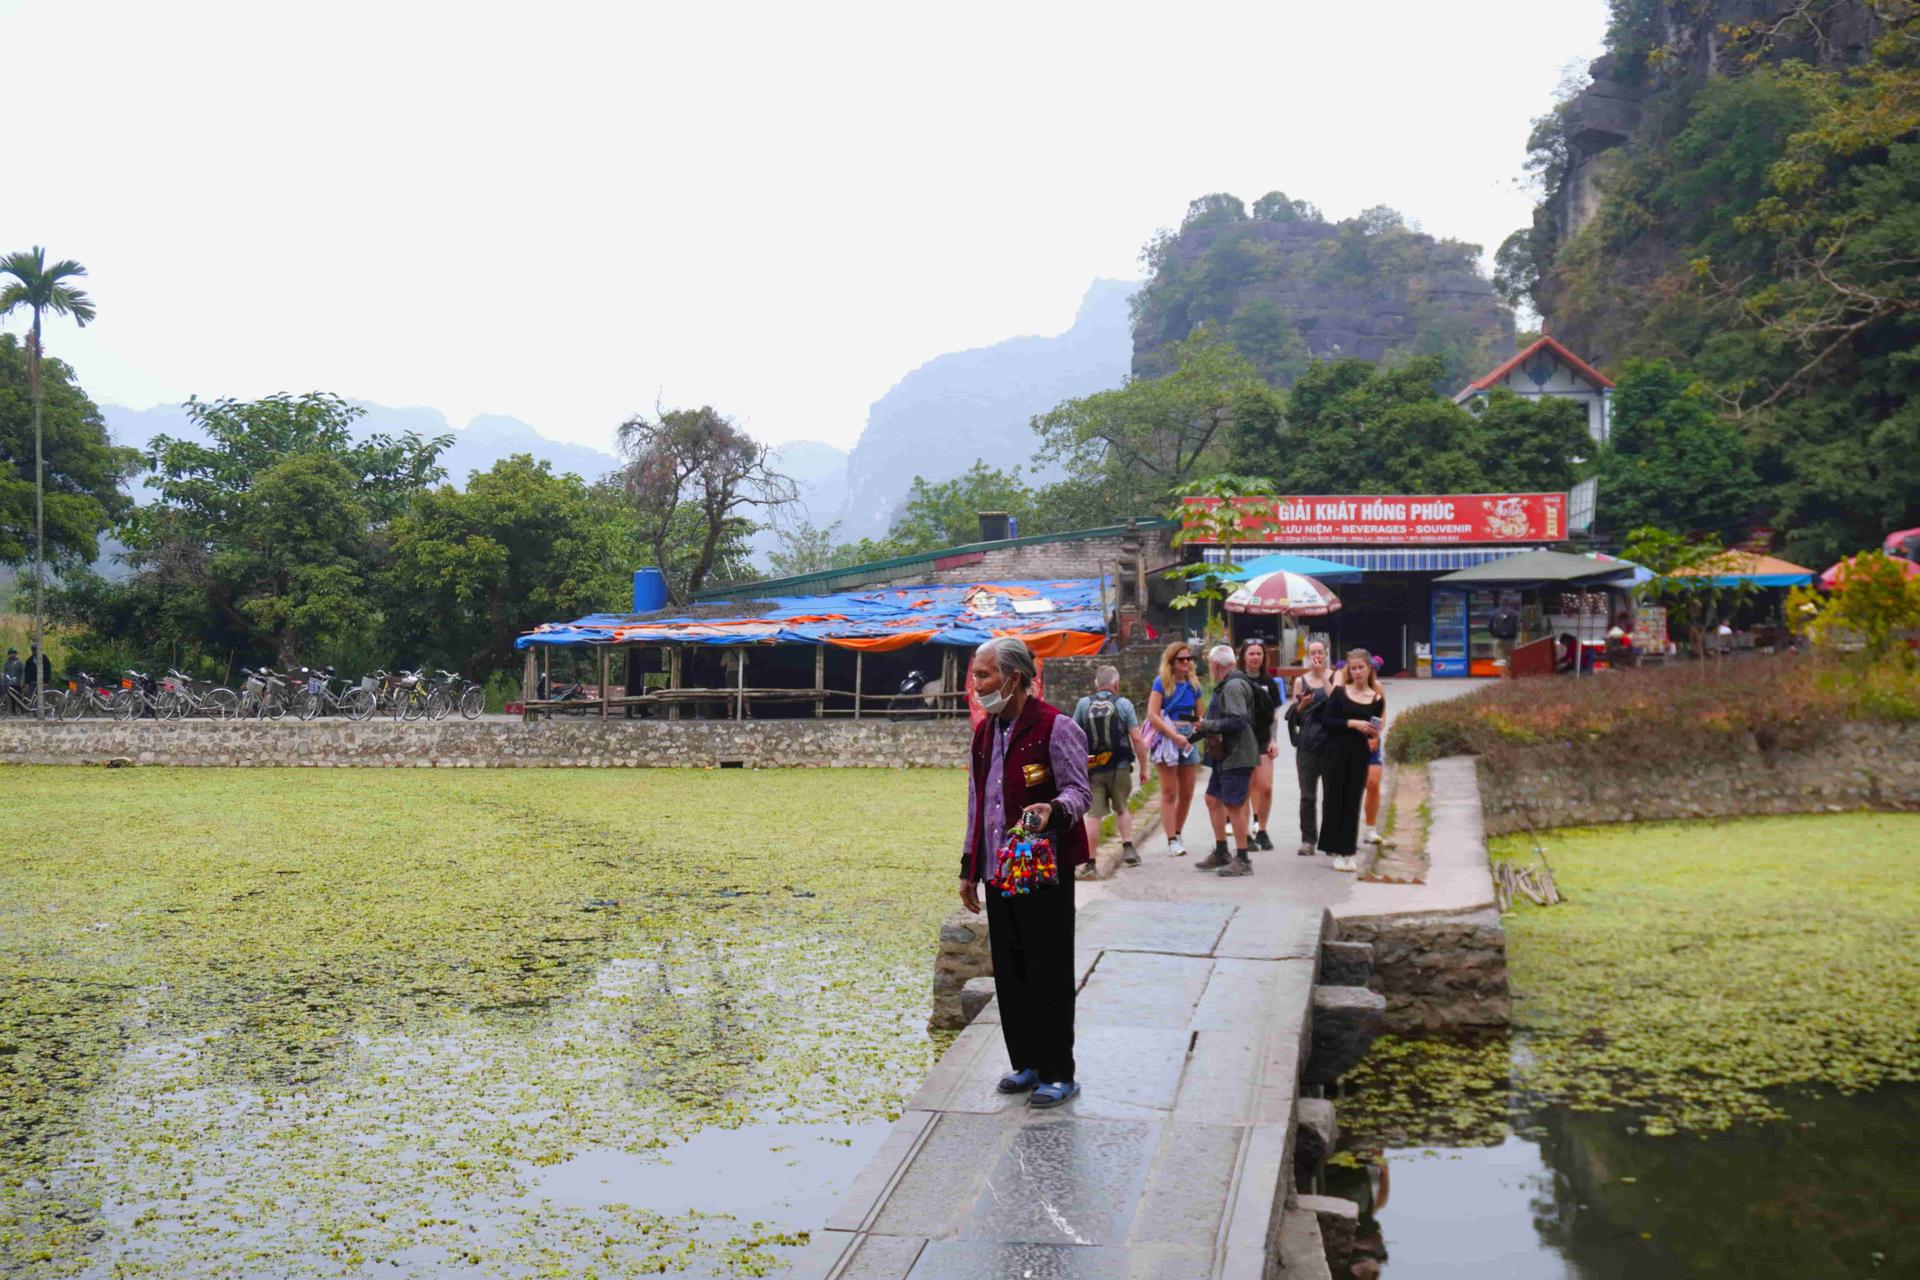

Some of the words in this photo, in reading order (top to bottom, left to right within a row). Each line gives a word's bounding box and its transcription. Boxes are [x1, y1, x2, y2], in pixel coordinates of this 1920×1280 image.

[1315, 501, 1357, 521] KHÁT
[1410, 501, 1455, 521] PHÚC
[1342, 525, 1407, 533] BEVERAGES
[1416, 524, 1472, 533] SOUVENIR
